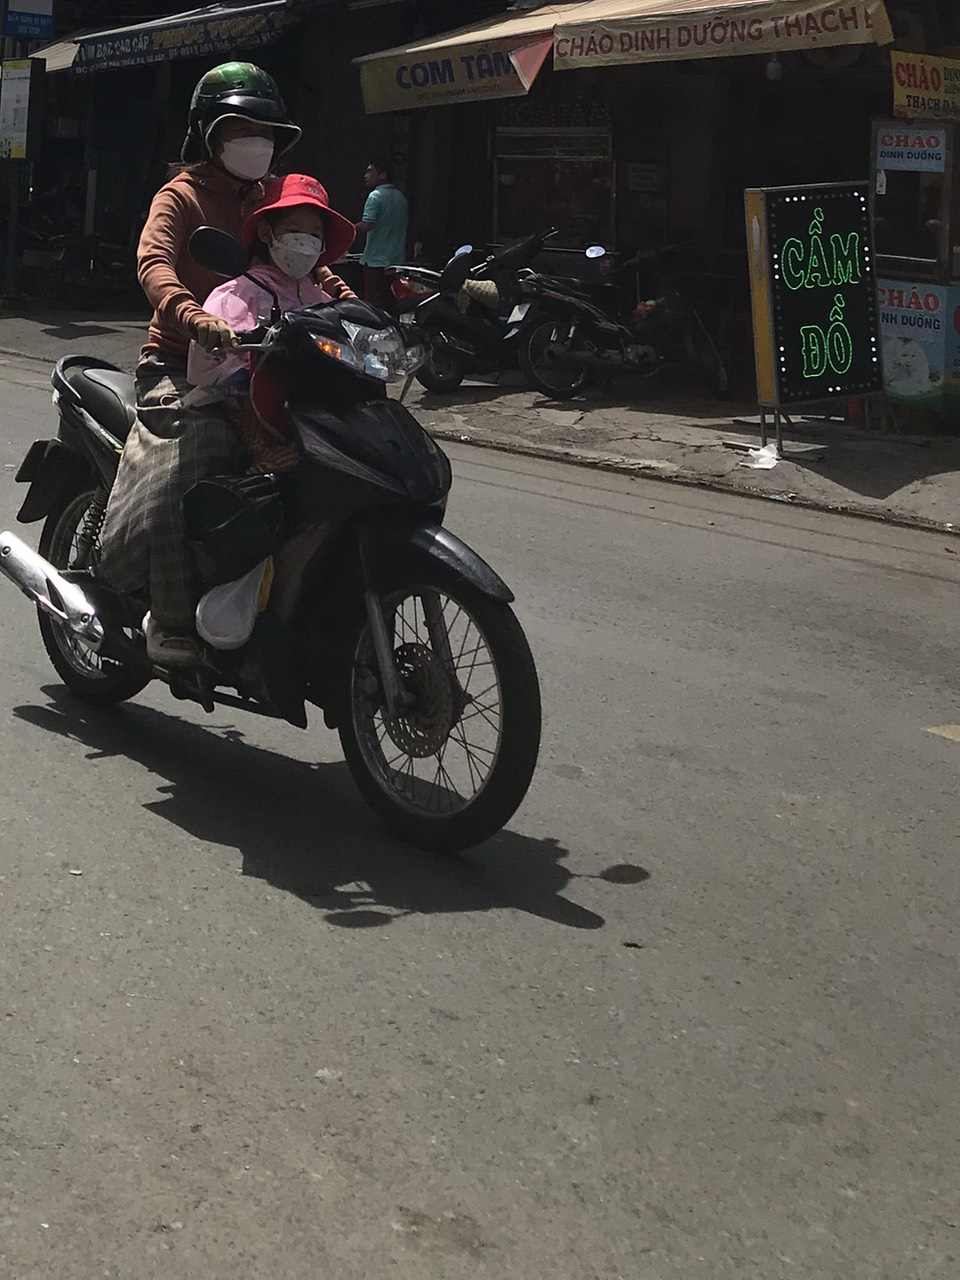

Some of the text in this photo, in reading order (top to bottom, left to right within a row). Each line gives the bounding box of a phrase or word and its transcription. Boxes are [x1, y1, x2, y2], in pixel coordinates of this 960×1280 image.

[555, 29, 613, 58] CHÁO
[620, 31, 670, 54] DINH
[677, 16, 763, 48] DƯỠNG
[771, 7, 858, 43] THẠCH
[880, 132, 940, 148] CHÁO
[880, 149, 942, 161] DINH DƯỠNG
[781, 207, 862, 290] CẦM
[877, 287, 940, 311] CHÁO
[901, 313, 940, 330] DƯỠNG
[800, 293, 853, 378] ĐỒ
